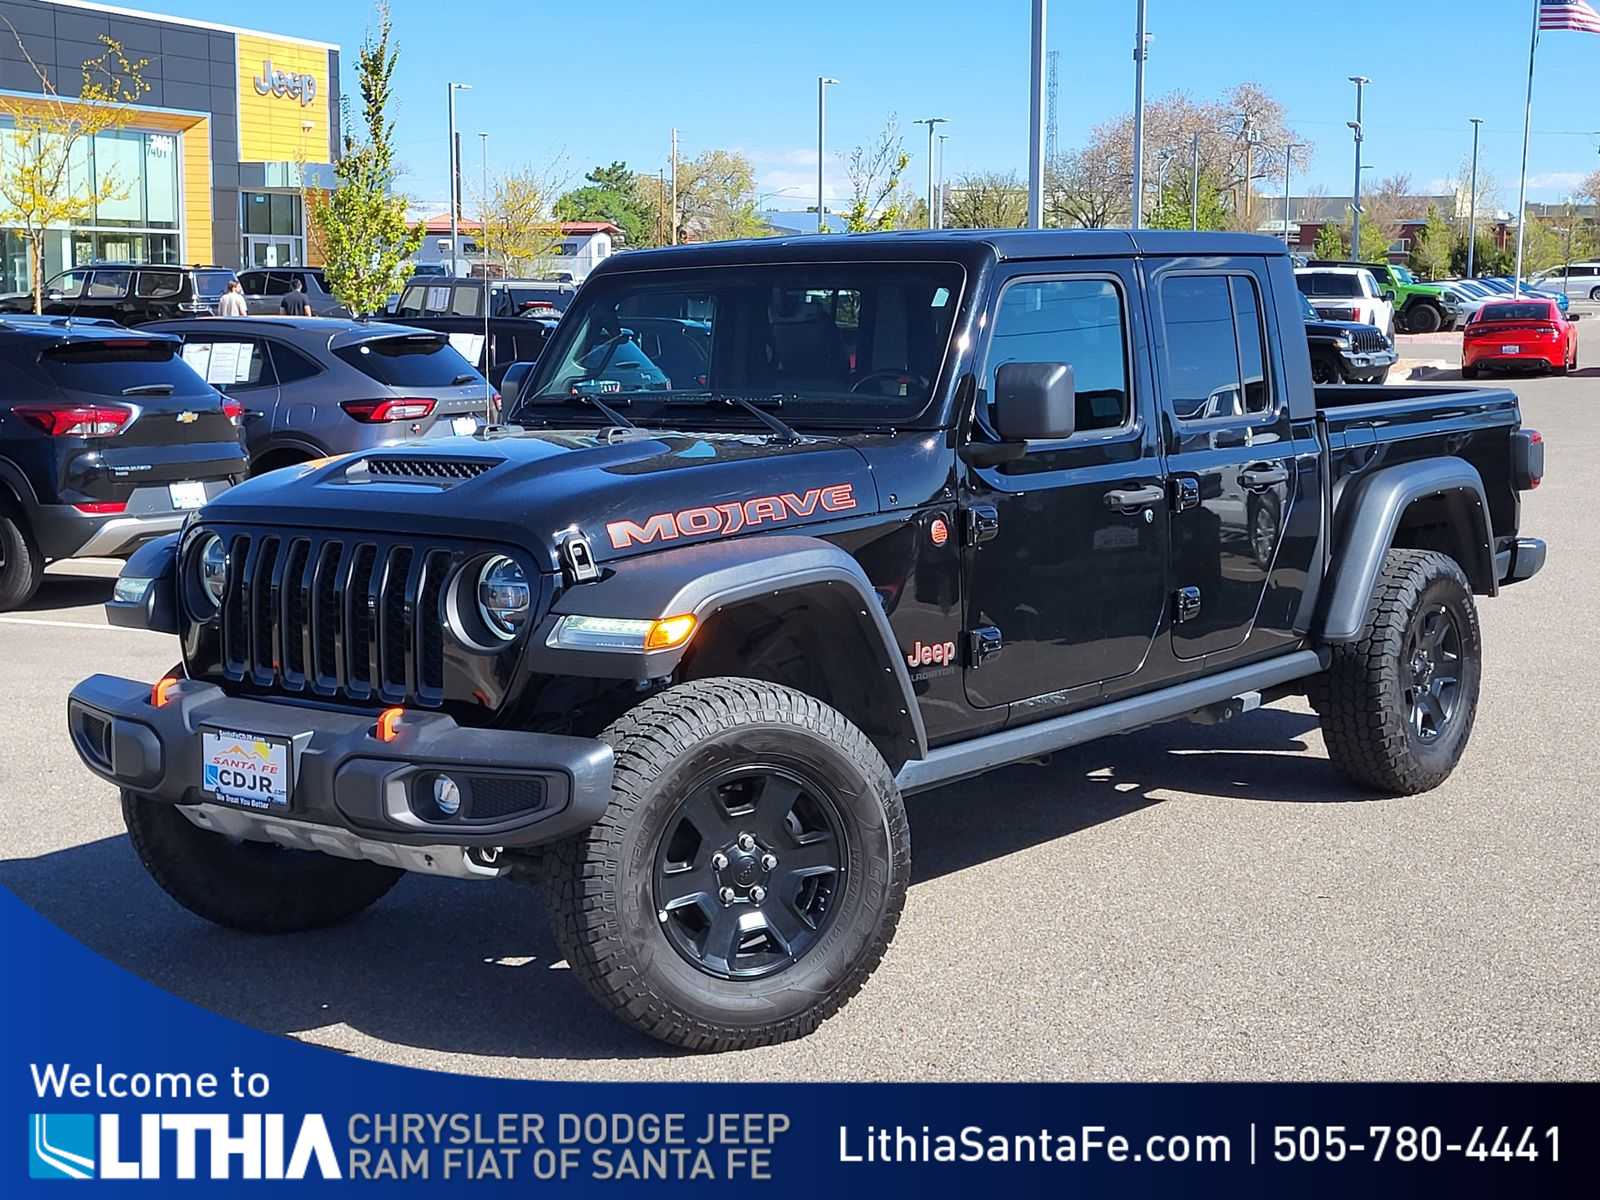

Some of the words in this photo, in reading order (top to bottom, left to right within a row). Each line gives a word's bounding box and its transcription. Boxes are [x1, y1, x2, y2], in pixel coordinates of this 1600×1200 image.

[254, 60, 317, 107] Jeep
[606, 483, 857, 549] MOJAVE
[907, 641, 956, 667] Jeep
[213, 757, 257, 771] SANTA
[262, 764, 279, 775] FE
[219, 769, 273, 794] CDJR
